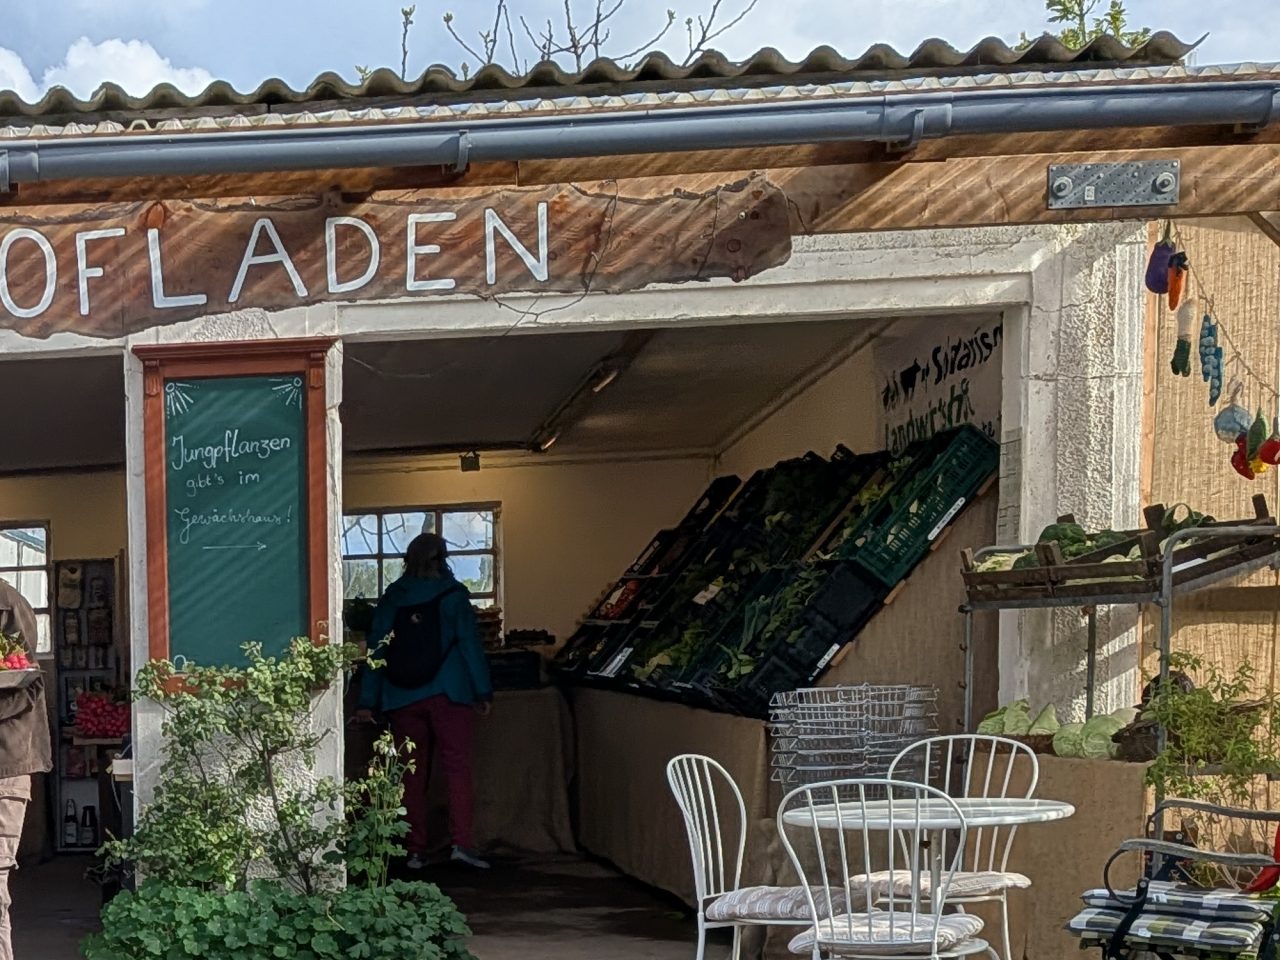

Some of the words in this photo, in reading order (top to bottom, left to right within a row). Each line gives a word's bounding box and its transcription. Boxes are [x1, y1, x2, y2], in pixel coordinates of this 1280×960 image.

[172, 429, 291, 470] Jungpflanzen
[186, 473, 224, 497] gibt's
[239, 471, 260, 485] im
